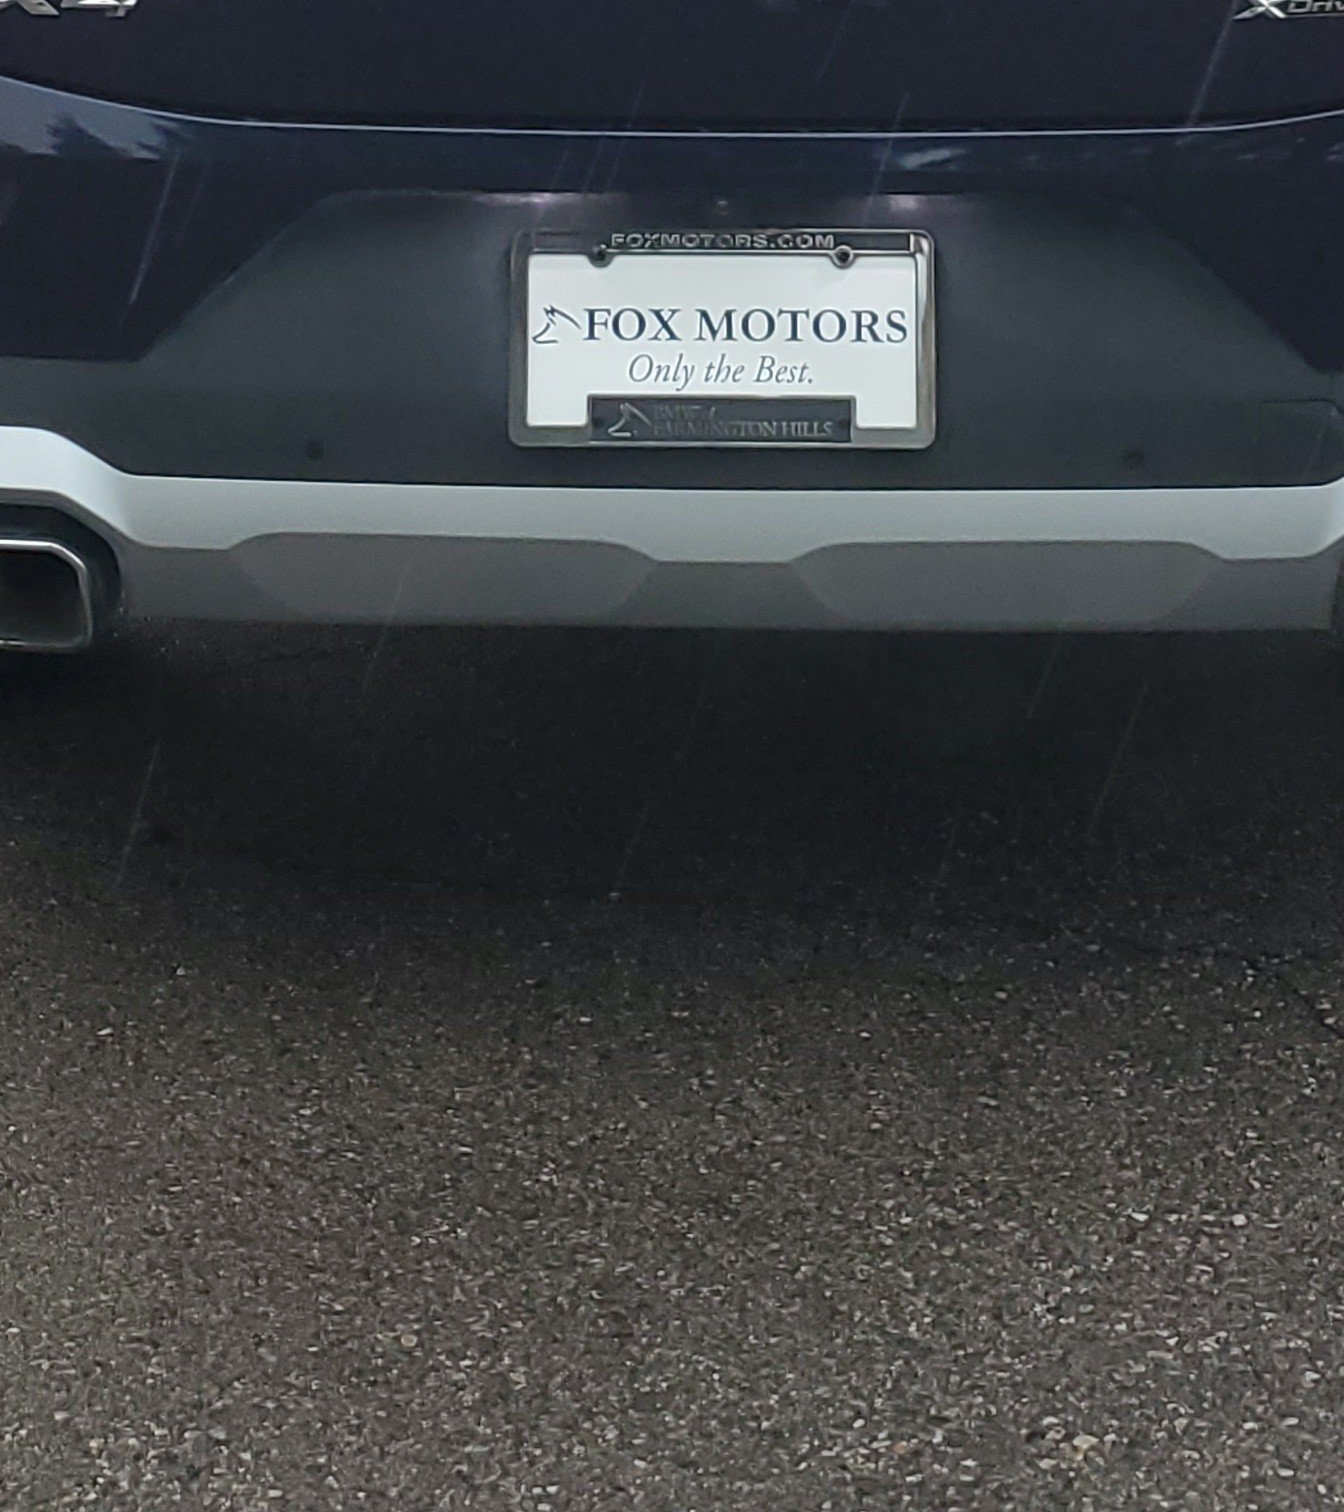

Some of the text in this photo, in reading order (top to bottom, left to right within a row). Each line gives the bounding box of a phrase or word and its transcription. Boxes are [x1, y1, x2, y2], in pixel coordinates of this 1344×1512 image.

[610, 233, 835, 249] FOXMOTORS.COM
[582, 307, 909, 343] FOX MOTORS
[628, 353, 814, 391] Only the Best.
[782, 420, 834, 437] HILLS
